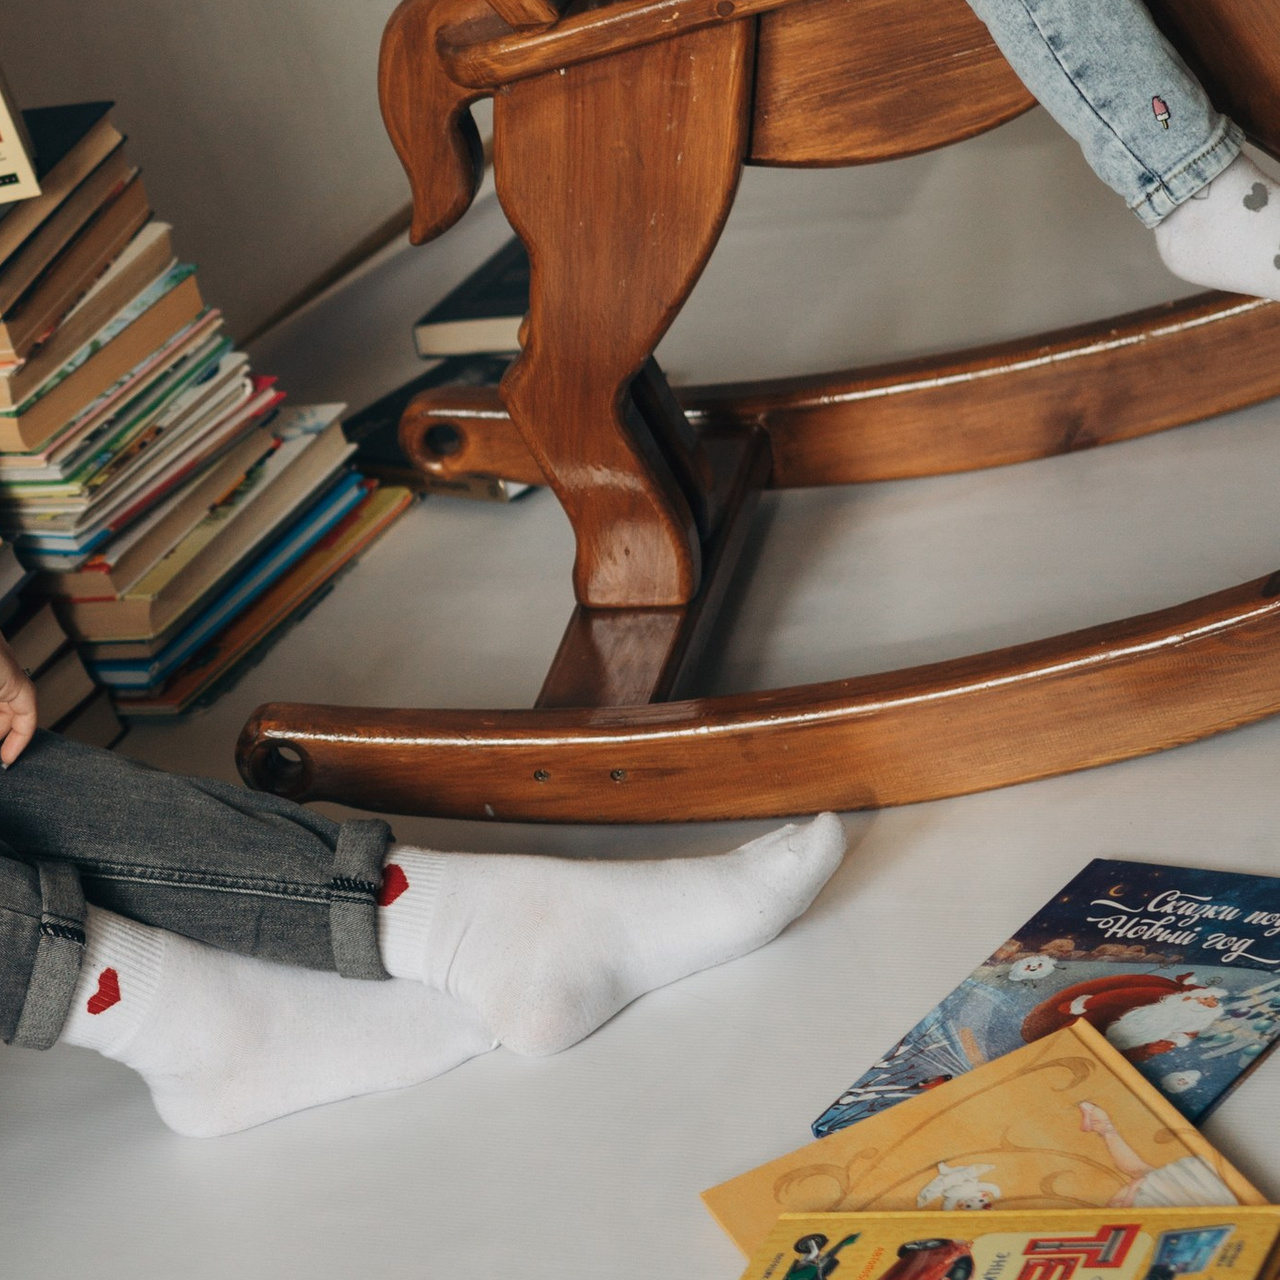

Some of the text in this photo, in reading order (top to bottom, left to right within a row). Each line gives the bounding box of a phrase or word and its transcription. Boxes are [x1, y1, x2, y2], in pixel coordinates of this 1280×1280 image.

[1146, 889, 1241, 927] Сказки
[1087, 915, 1280, 964] Новый год
